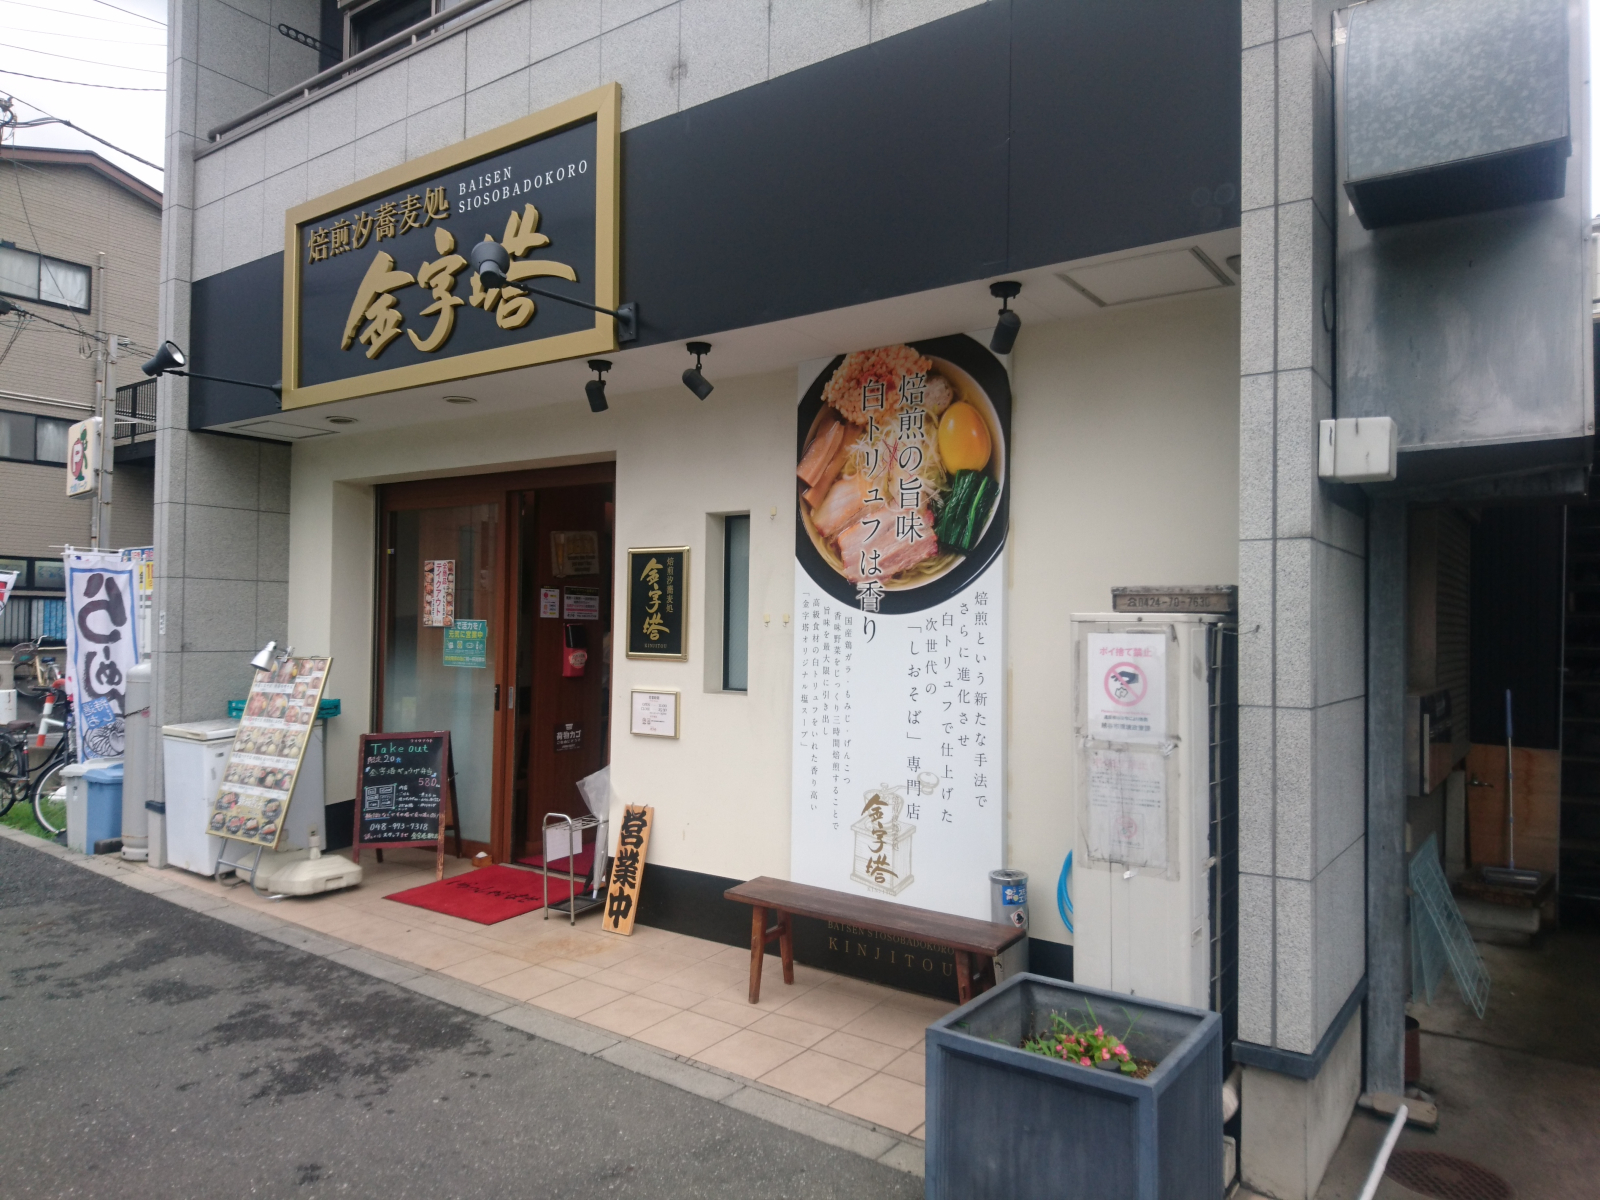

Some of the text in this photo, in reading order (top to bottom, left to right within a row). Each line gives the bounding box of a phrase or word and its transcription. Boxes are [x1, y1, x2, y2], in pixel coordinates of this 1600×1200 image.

[307, 185, 450, 264] 焙煎汐蕎麦処
[458, 165, 513, 196] BAISEN
[458, 159, 588, 213] SIOSOBADOKORO
[340, 203, 580, 360] 金字塔
[858, 378, 885, 643] 白トリュフは香り
[897, 373, 927, 543] 焙煎の旨味
[640, 557, 670, 641] 金字塔
[821, 606, 830, 736] 旨味を最大限に引き出し
[925, 617, 938, 695] 次世代の
[957, 602, 971, 747] さらに進化させ
[974, 591, 988, 808] 焙煎という新たな手法で
[370, 742, 429, 755] Take out
[941, 612, 954, 823] 白トリュフで仕上げた
[607, 809, 648, 929] 営業中
[860, 793, 899, 884] 金字塔
[828, 936, 953, 977] KINJITOU
